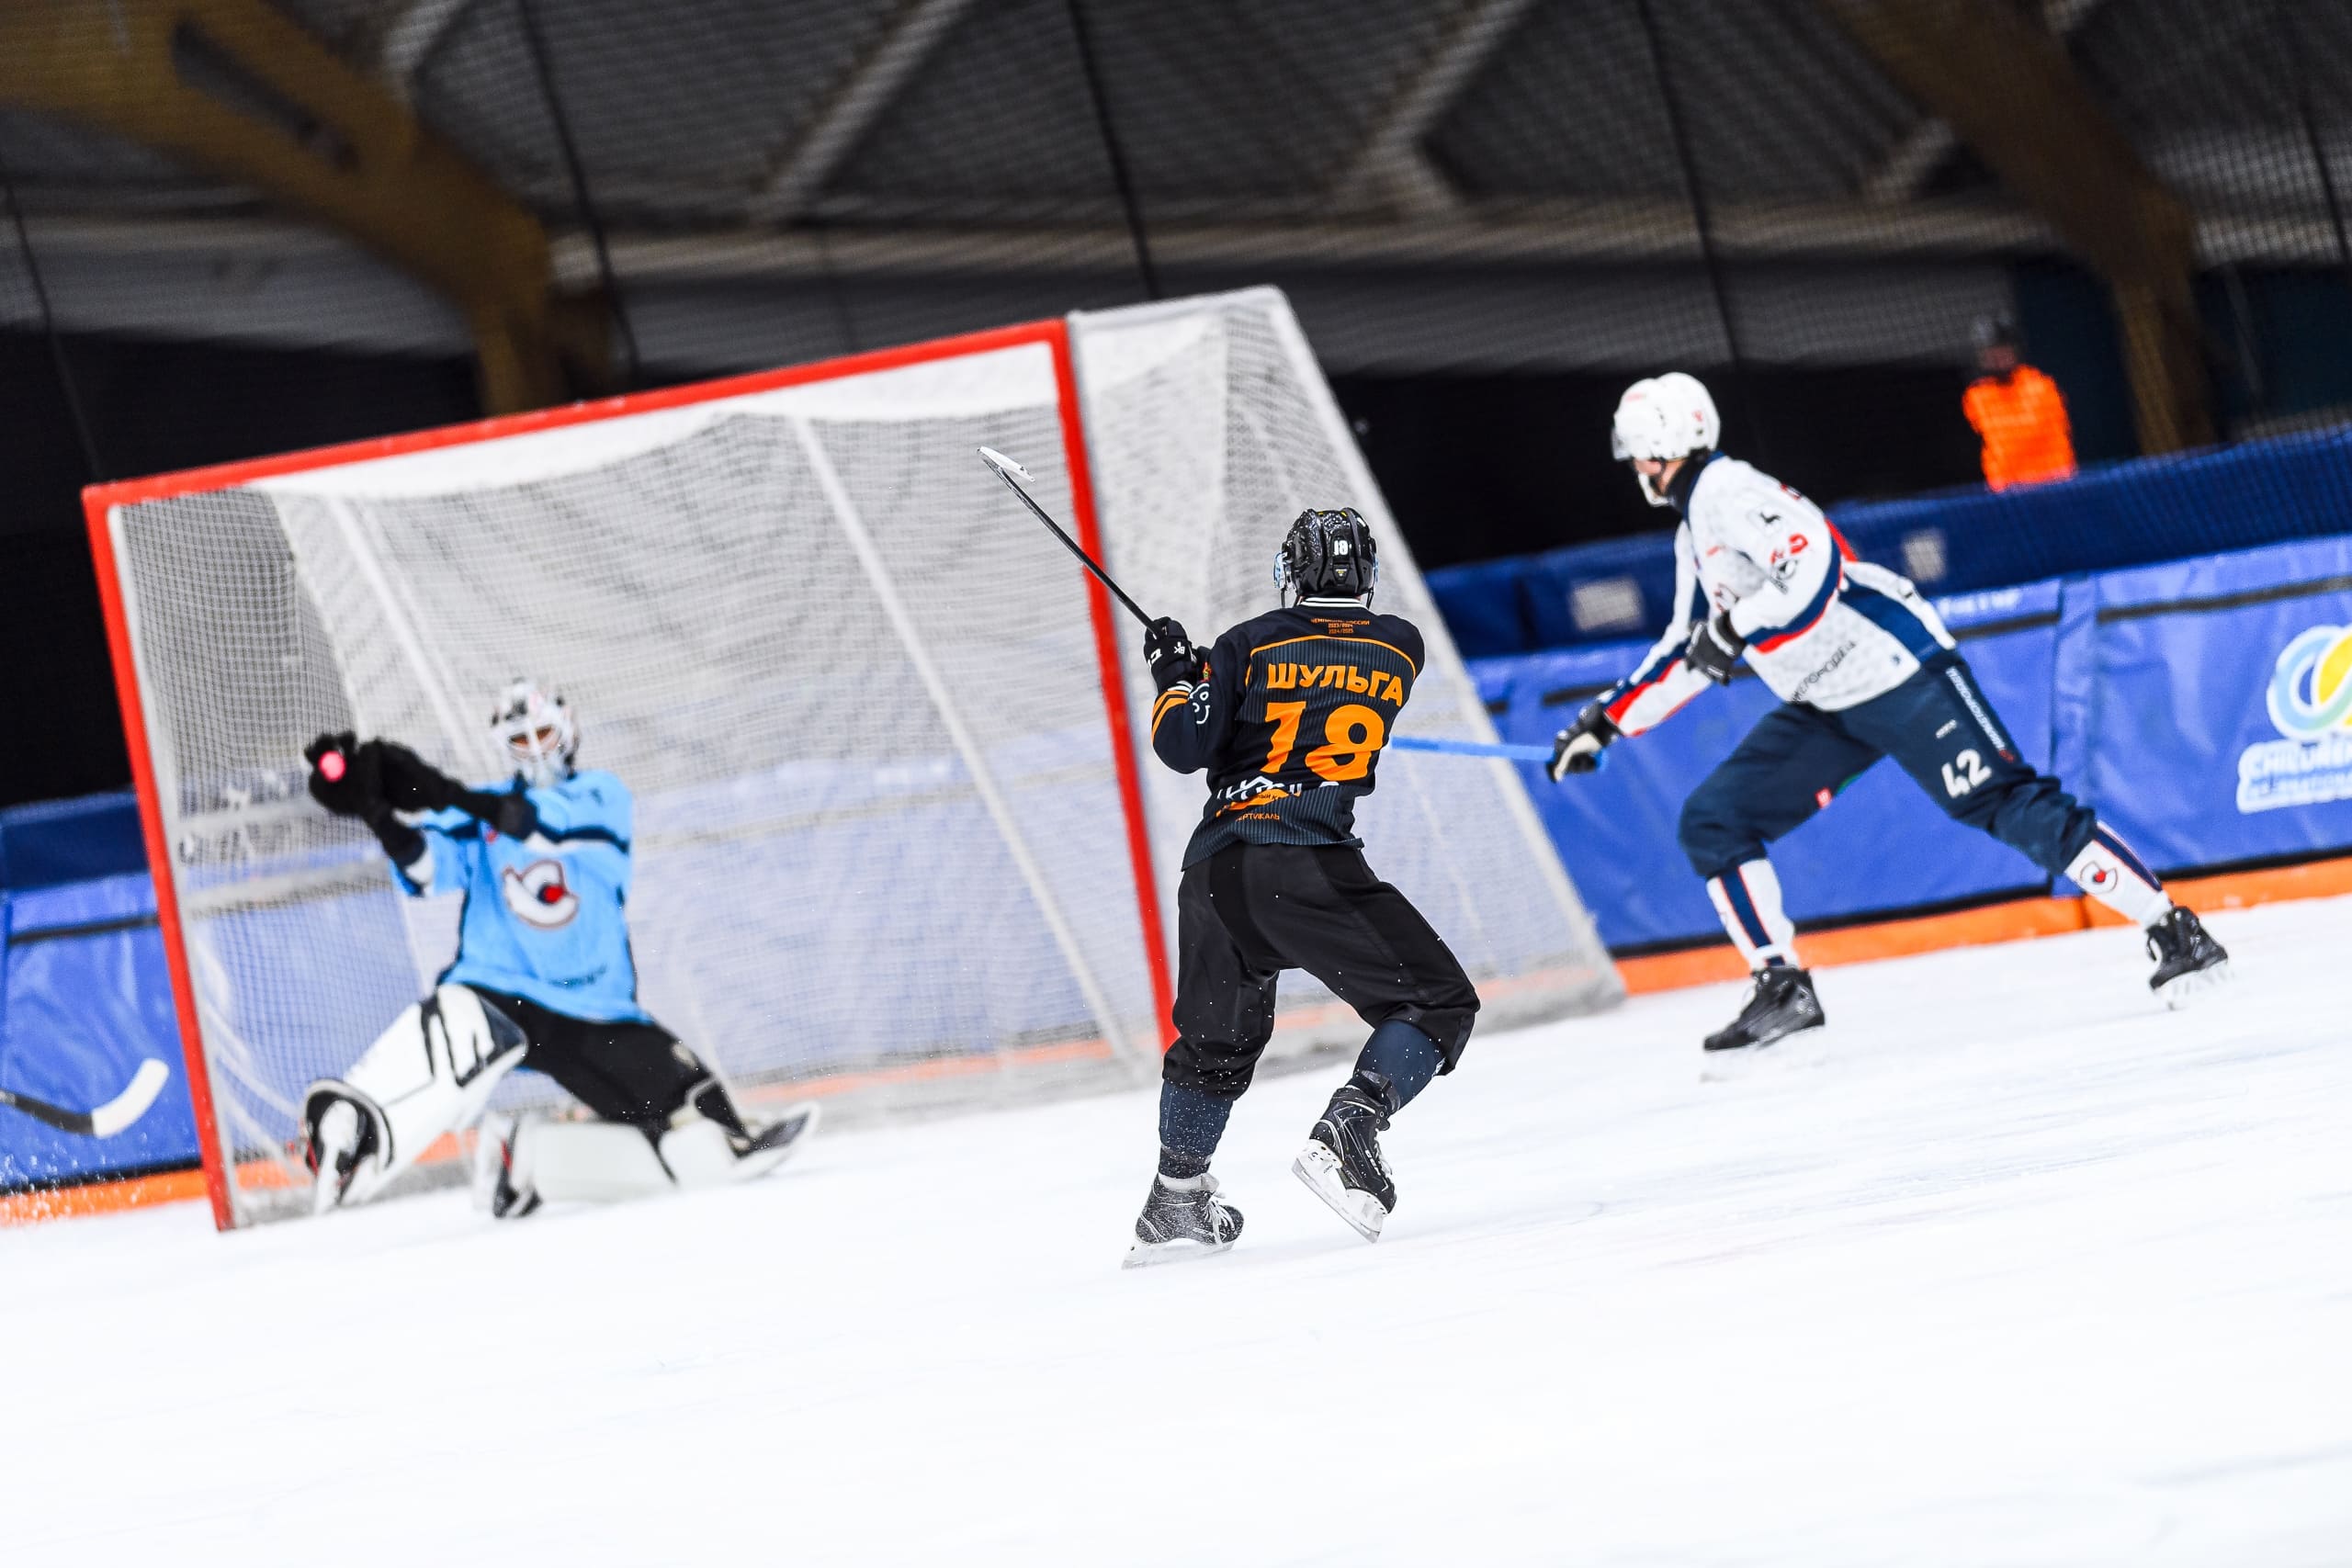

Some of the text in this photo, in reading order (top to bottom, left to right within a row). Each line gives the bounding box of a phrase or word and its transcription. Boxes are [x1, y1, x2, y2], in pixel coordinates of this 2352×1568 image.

[1334, 540, 1349, 556] 18
[1266, 662, 1403, 707] ШУЛЬГА
[1260, 701, 1385, 781] 18
[1941, 749, 1992, 798] 42
